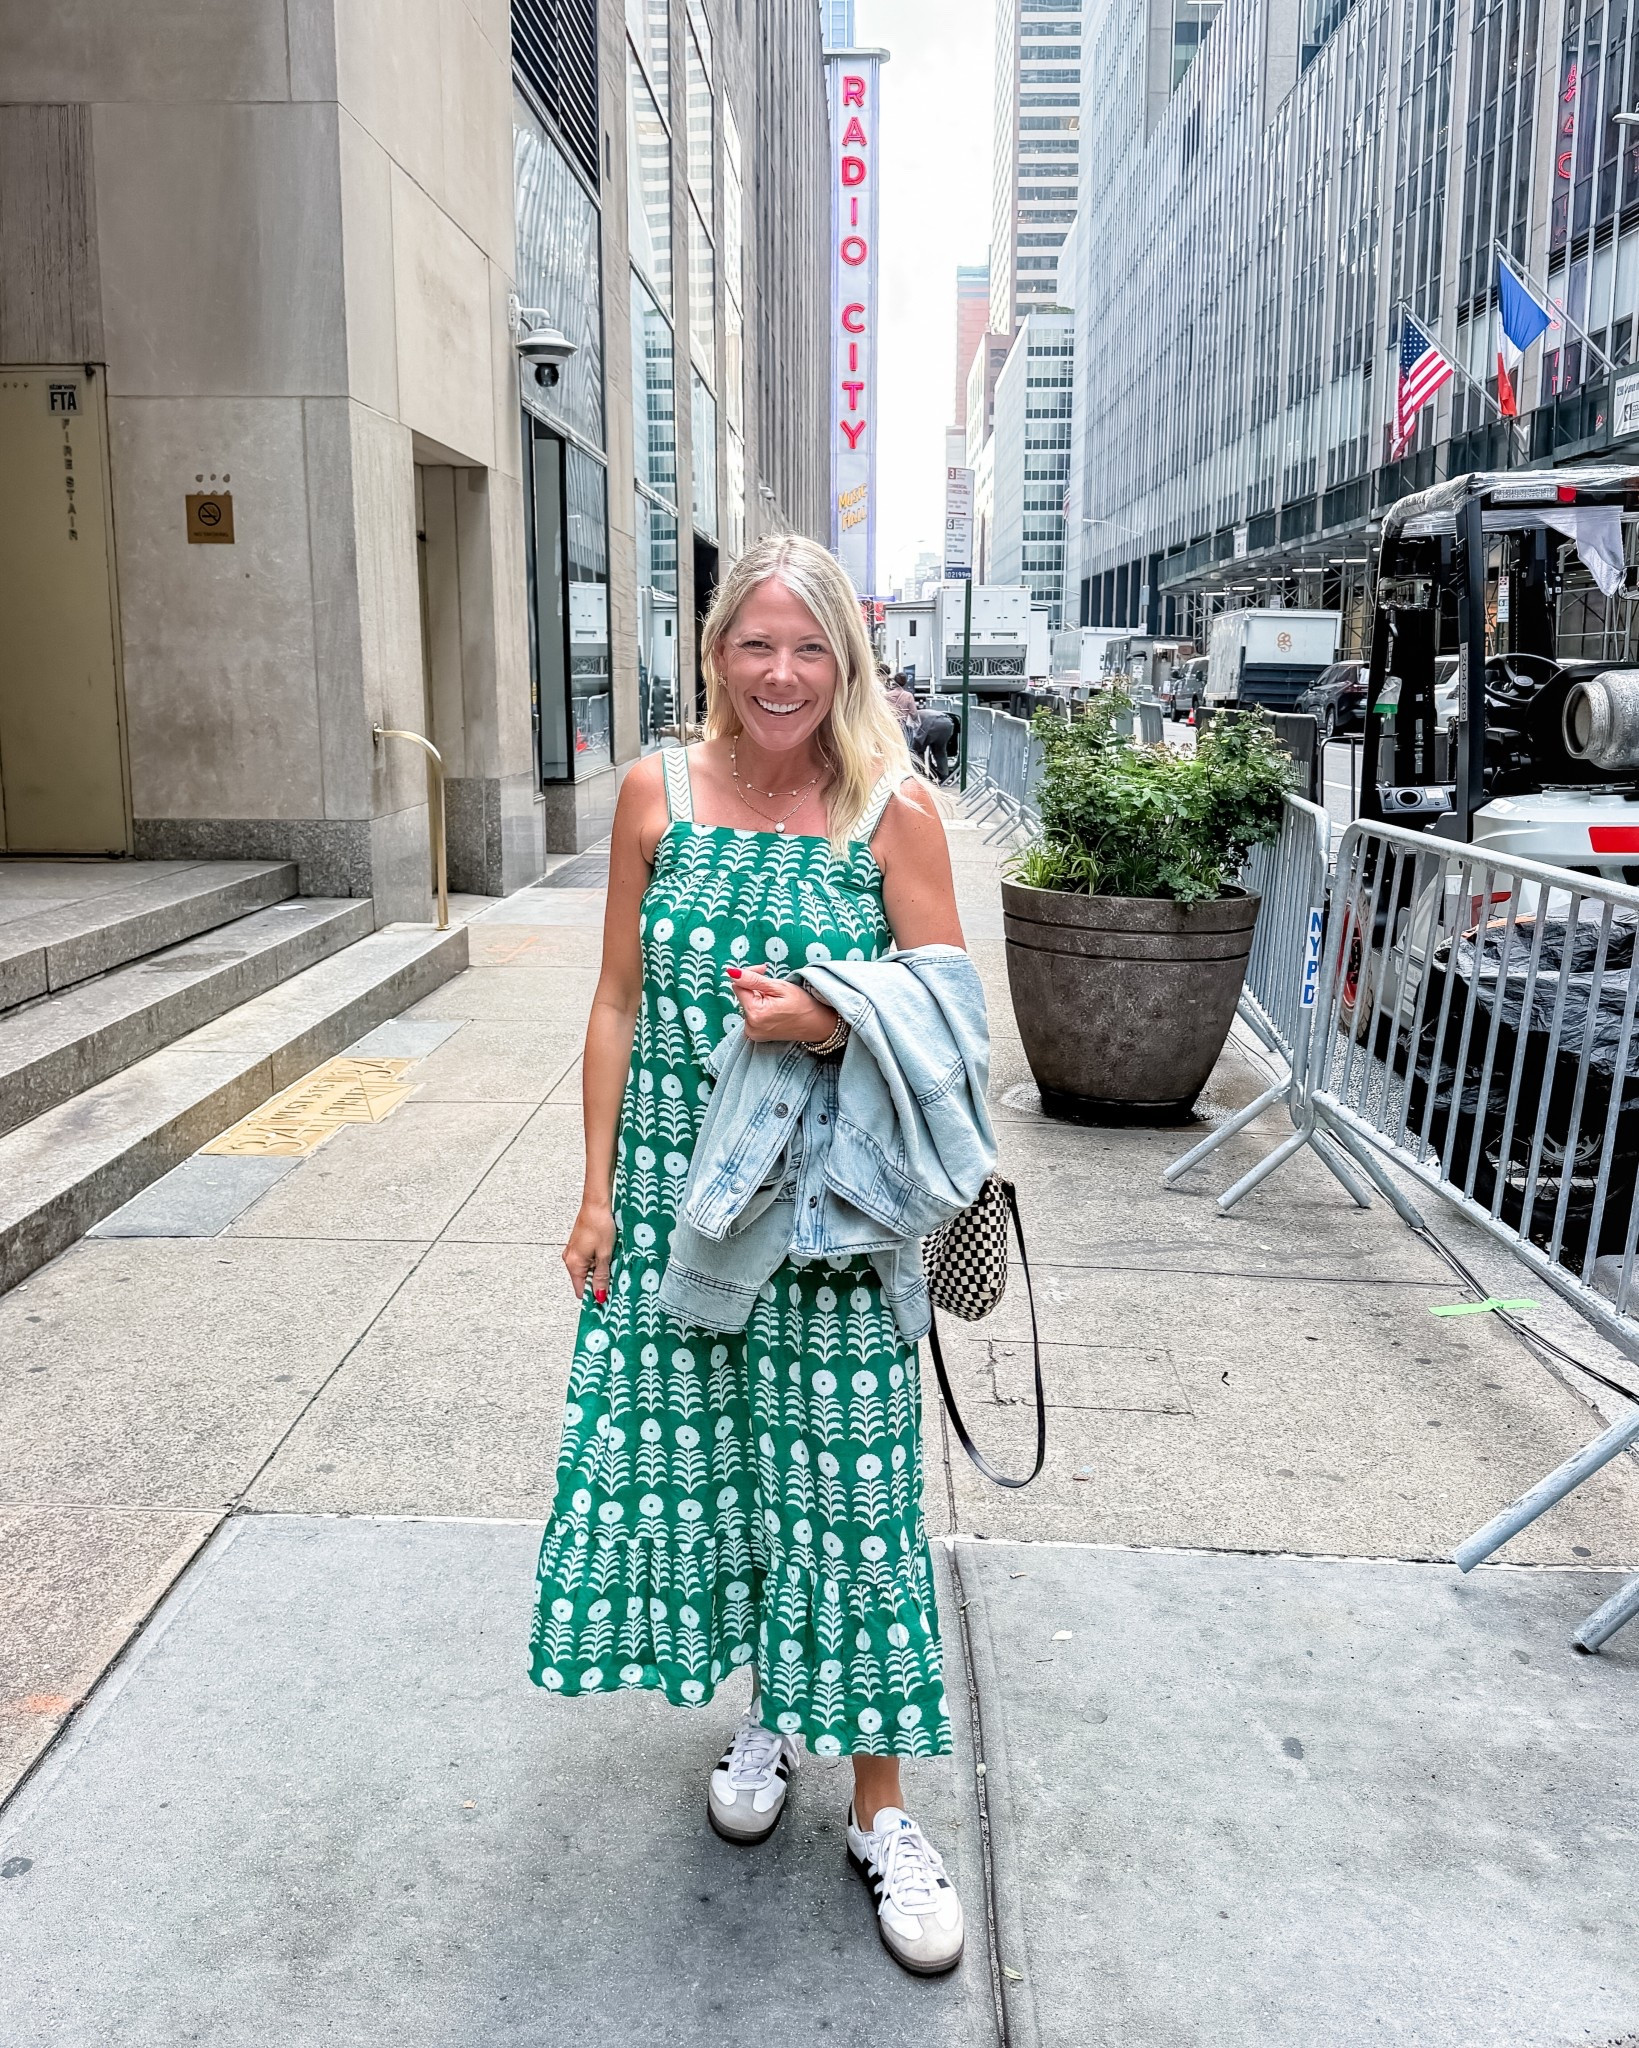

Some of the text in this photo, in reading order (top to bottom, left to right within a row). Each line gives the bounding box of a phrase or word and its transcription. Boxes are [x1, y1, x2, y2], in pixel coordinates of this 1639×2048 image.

[839, 75, 868, 449] RADIO CITY
[50, 392, 77, 410] FTA
[61, 418, 78, 541] FIRE STAIR
[949, 468, 955, 479] 3
[947, 519, 953, 529] 6
[1303, 912, 1323, 1004] NYPD
